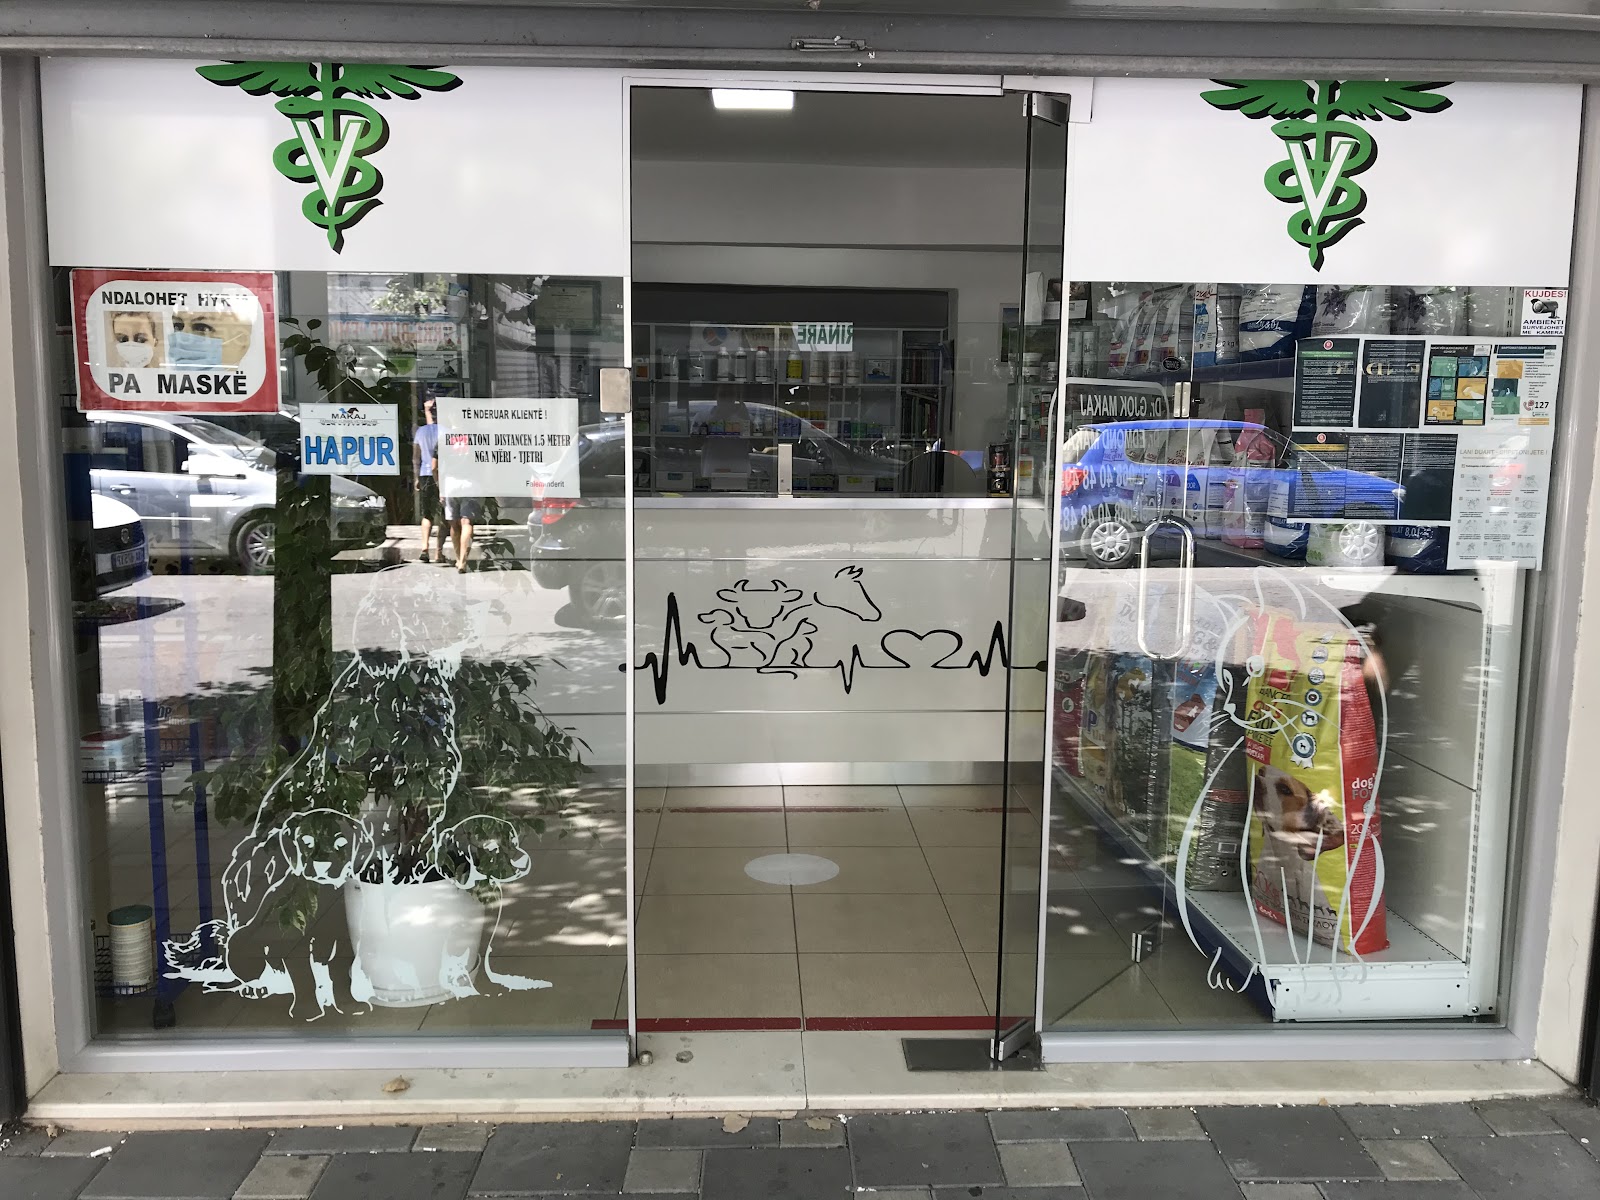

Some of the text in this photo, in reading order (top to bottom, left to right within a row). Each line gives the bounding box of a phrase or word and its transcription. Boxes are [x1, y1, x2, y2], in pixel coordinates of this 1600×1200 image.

[101, 290, 188, 307] NDALOHET
[1525, 290, 1567, 298] KUJDES!
[108, 371, 248, 395] PA MASKË
[1534, 401, 1550, 409] 127
[473, 409, 510, 420] NDERUAR
[494, 433, 532, 446] DISTANCEN
[534, 434, 546, 446] 1.5
[547, 434, 571, 446] METER
[304, 435, 396, 466] HAPUR
[474, 450, 490, 463] NGA
[491, 449, 512, 464] NJËRI
[518, 450, 543, 464] TJETRI
[525, 480, 565, 488] Falemnderit
